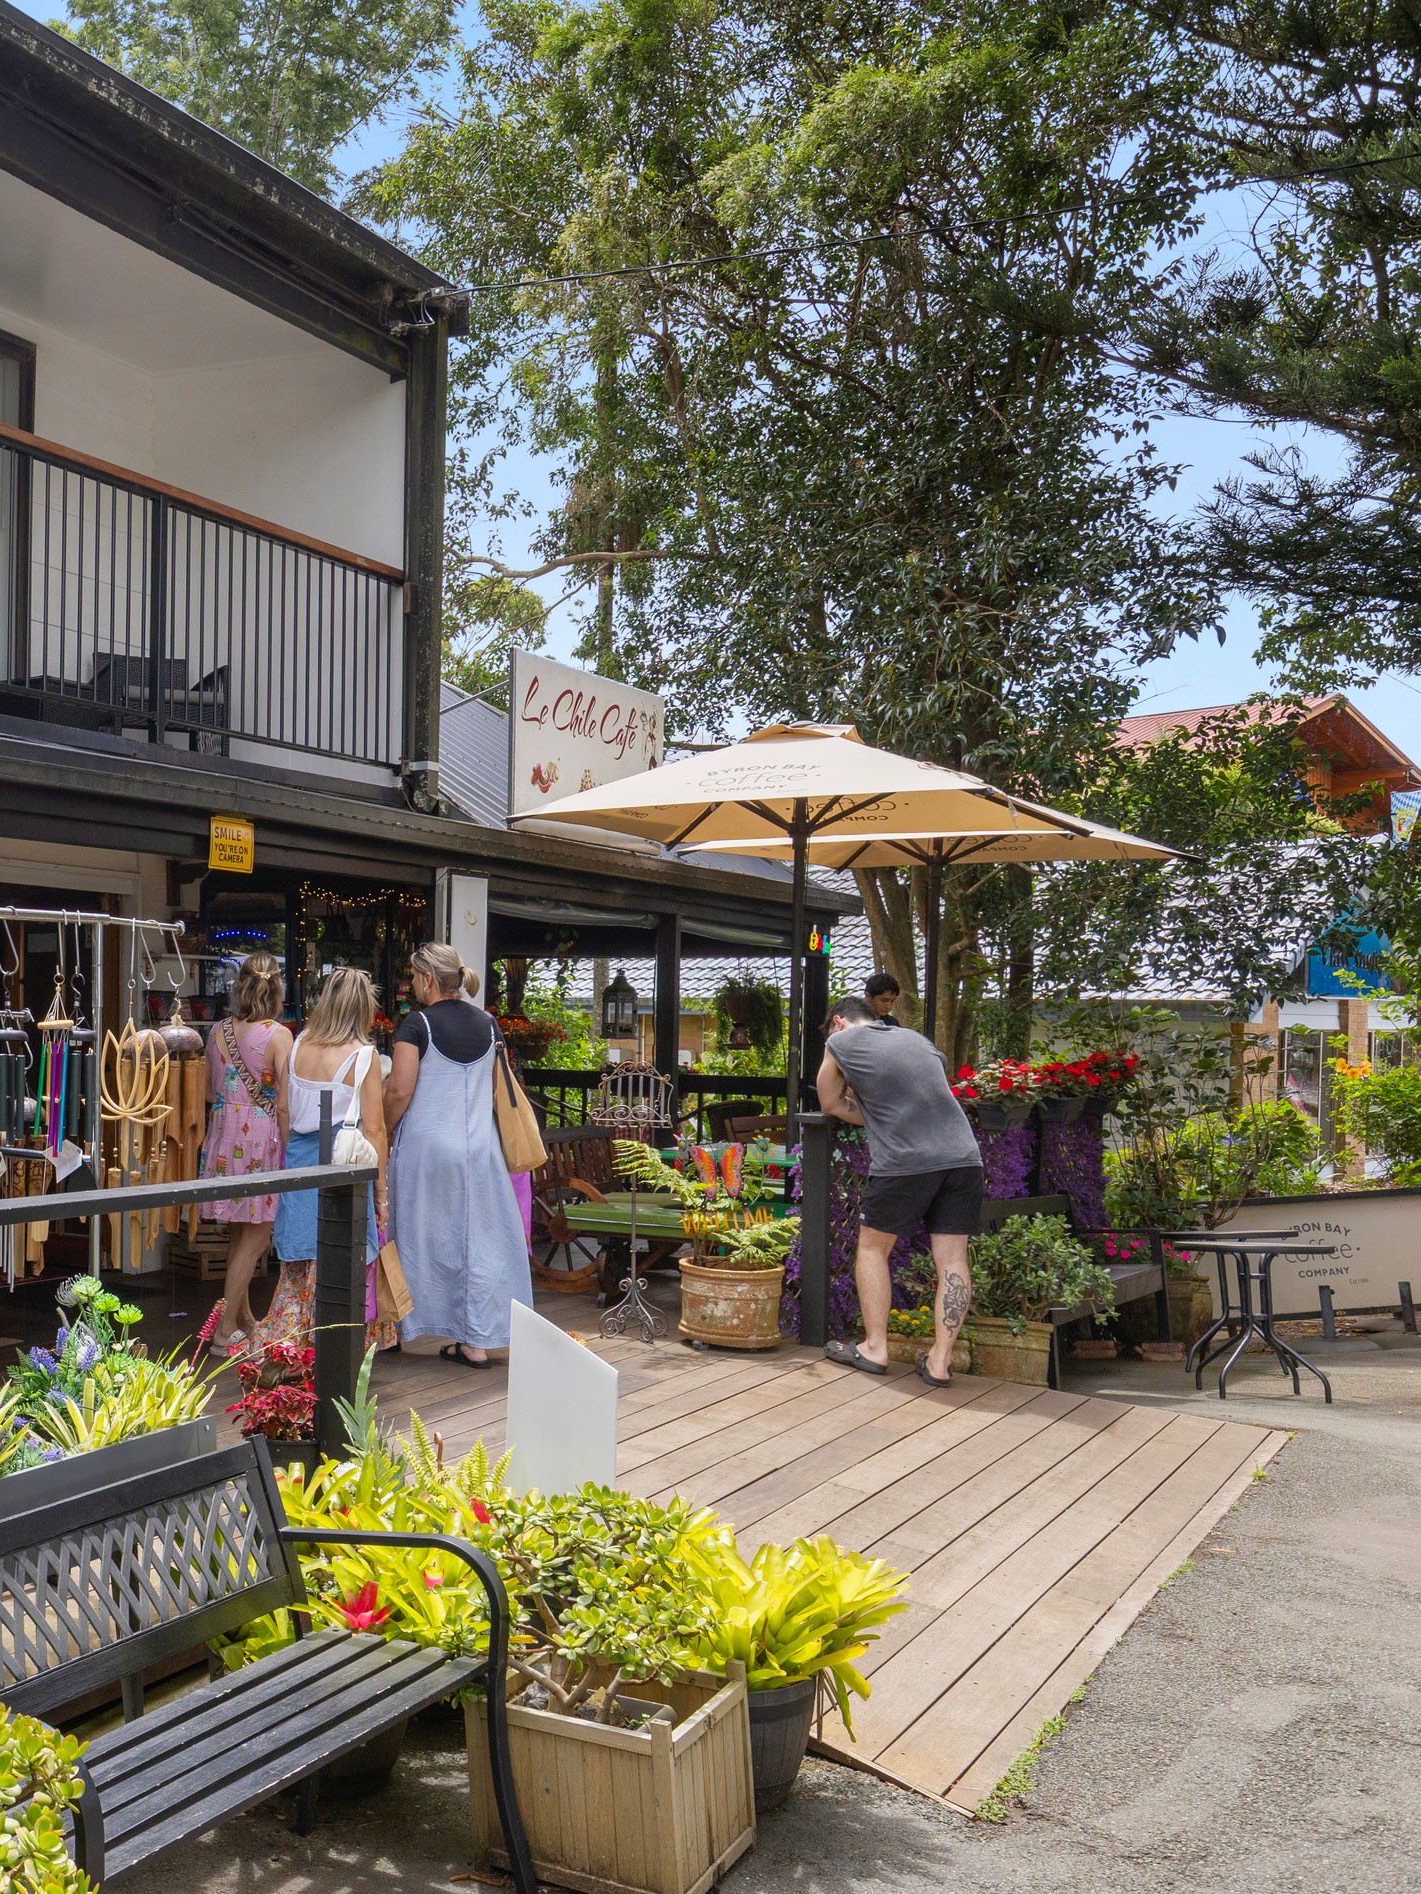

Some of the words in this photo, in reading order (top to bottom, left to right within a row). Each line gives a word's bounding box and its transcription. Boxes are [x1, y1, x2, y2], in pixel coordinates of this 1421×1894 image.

[521, 675, 549, 730] Le
[552, 689, 597, 739] Chile
[600, 704, 639, 760] Café
[708, 764, 778, 776] BYRON
[703, 784, 788, 793] COMPANY
[214, 826, 242, 842] SMILE
[214, 843, 238, 854] YOU'RE
[238, 846, 249, 855] ON
[218, 853, 244, 864] CAMERA
[1281, 1222, 1321, 1240] RON
[1324, 1222, 1351, 1236] BAY
[1298, 1266, 1350, 1279] COMPANY
